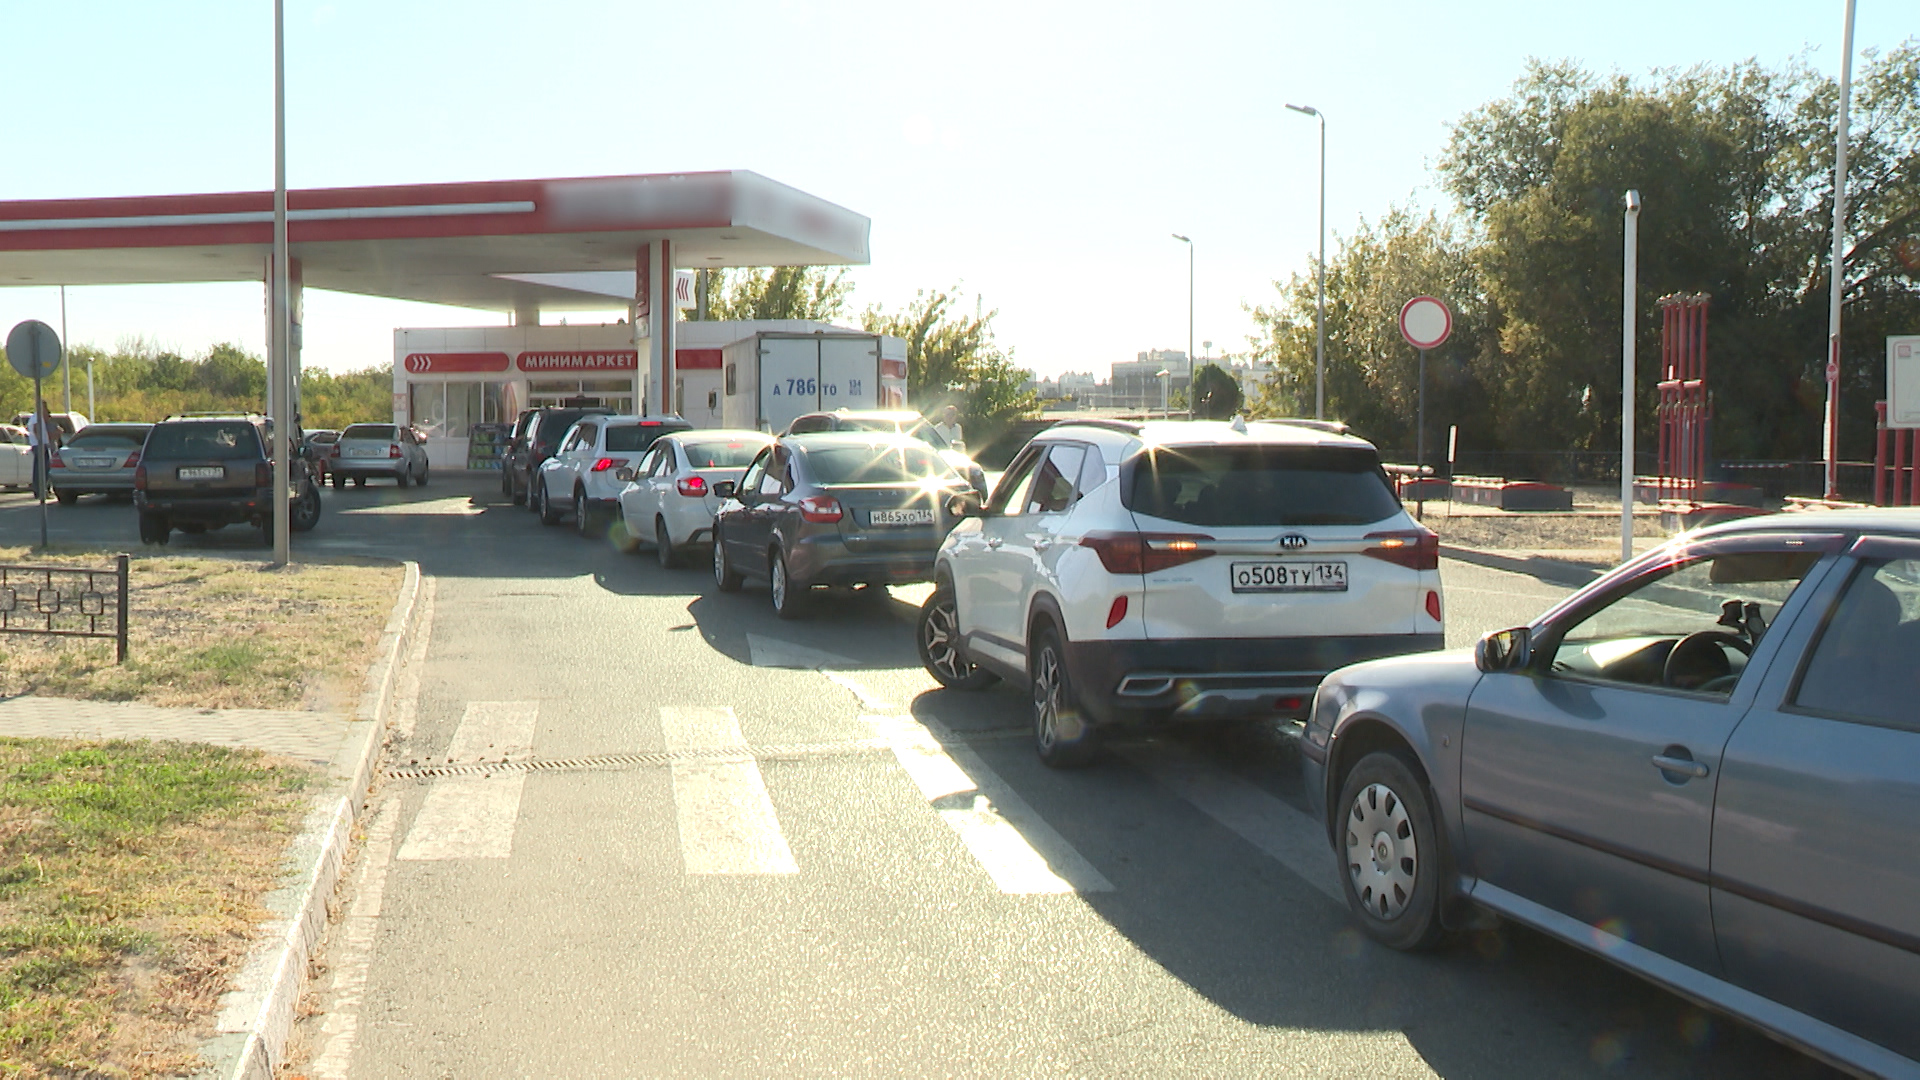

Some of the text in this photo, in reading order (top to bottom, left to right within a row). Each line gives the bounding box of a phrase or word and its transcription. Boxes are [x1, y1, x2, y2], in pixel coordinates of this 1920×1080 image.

[525, 354, 633, 368] МИНИМАРКЕТ
[773, 378, 837, 396] А 786 ТО
[1283, 537, 1305, 547] KIA
[1238, 565, 1342, 585] О508ТУ 134
